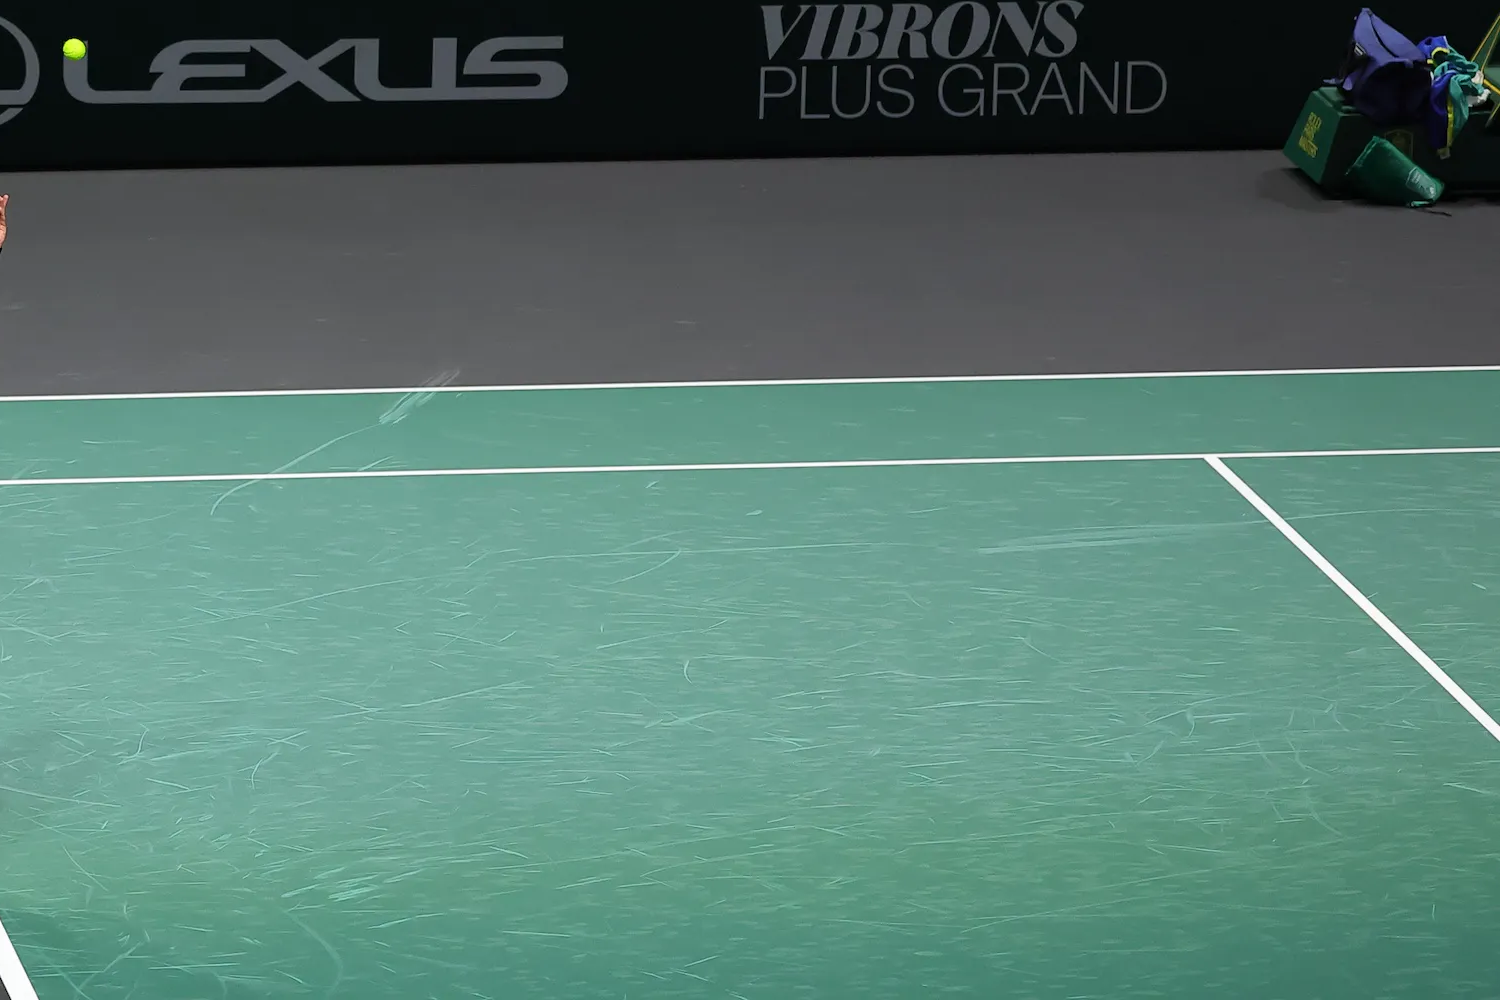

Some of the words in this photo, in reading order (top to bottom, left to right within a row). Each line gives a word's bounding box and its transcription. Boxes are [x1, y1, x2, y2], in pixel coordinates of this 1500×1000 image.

[760, 0, 1085, 61] VIBRONS
[62, 35, 569, 105] LEXUS
[759, 64, 915, 120] PLUS
[938, 60, 1168, 118] GRAND
